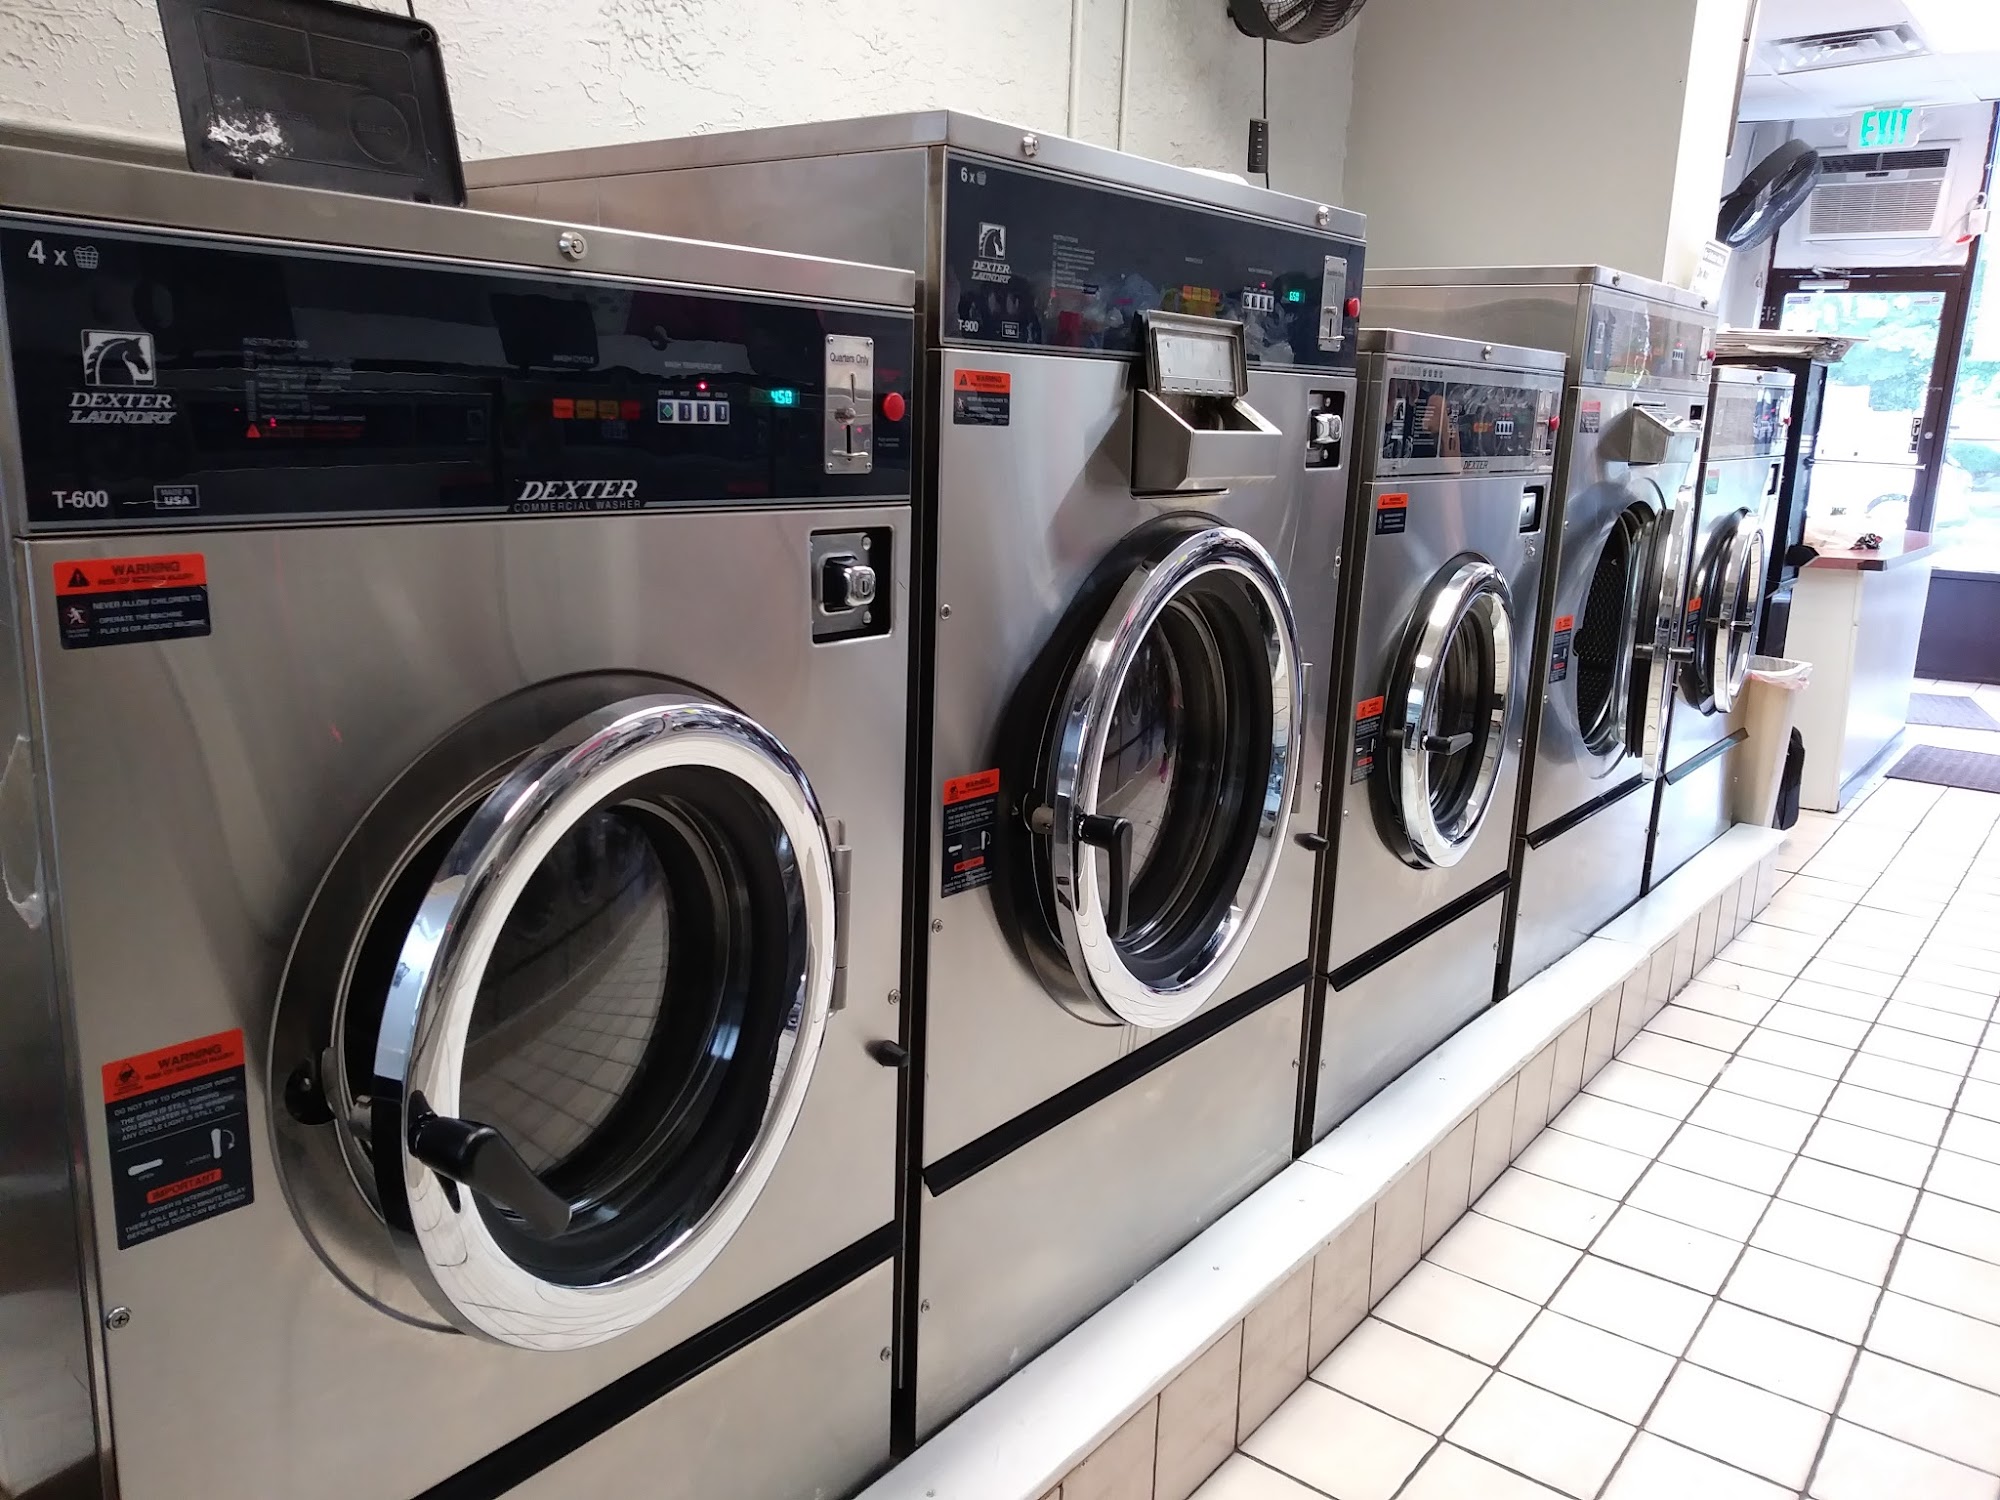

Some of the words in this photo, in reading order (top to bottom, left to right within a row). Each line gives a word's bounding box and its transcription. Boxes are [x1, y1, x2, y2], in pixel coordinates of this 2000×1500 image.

[1861, 108, 1912, 147] EXIT
[961, 166, 968, 183] 6
[27, 239, 46, 264] 4
[53, 249, 68, 266] x
[971, 259, 1010, 275] DEXTER
[971, 271, 1011, 284] LAUNDRY
[957, 319, 979, 333] T-900
[830, 352, 855, 363] Quarters
[856, 354, 870, 366] Only
[68, 392, 172, 409] DEXTER
[69, 410, 177, 424] LAUNDRY
[517, 480, 638, 500] DEXTER
[52, 490, 109, 508] T-600
[164, 495, 191, 505] USA
[513, 502, 591, 512] COMMERCIAL
[596, 500, 641, 510] WASHER
[112, 561, 180, 576] WARNING
[92, 601, 120, 609] NEVER
[122, 599, 150, 607] ALLOW
[150, 596, 190, 605] CHILDREN
[158, 1043, 222, 1069] WARNING
[127, 1103, 142, 1112] NOT
[138, 1124, 163, 1136] CYCLE
[151, 1172, 216, 1201] IMPORTANT
